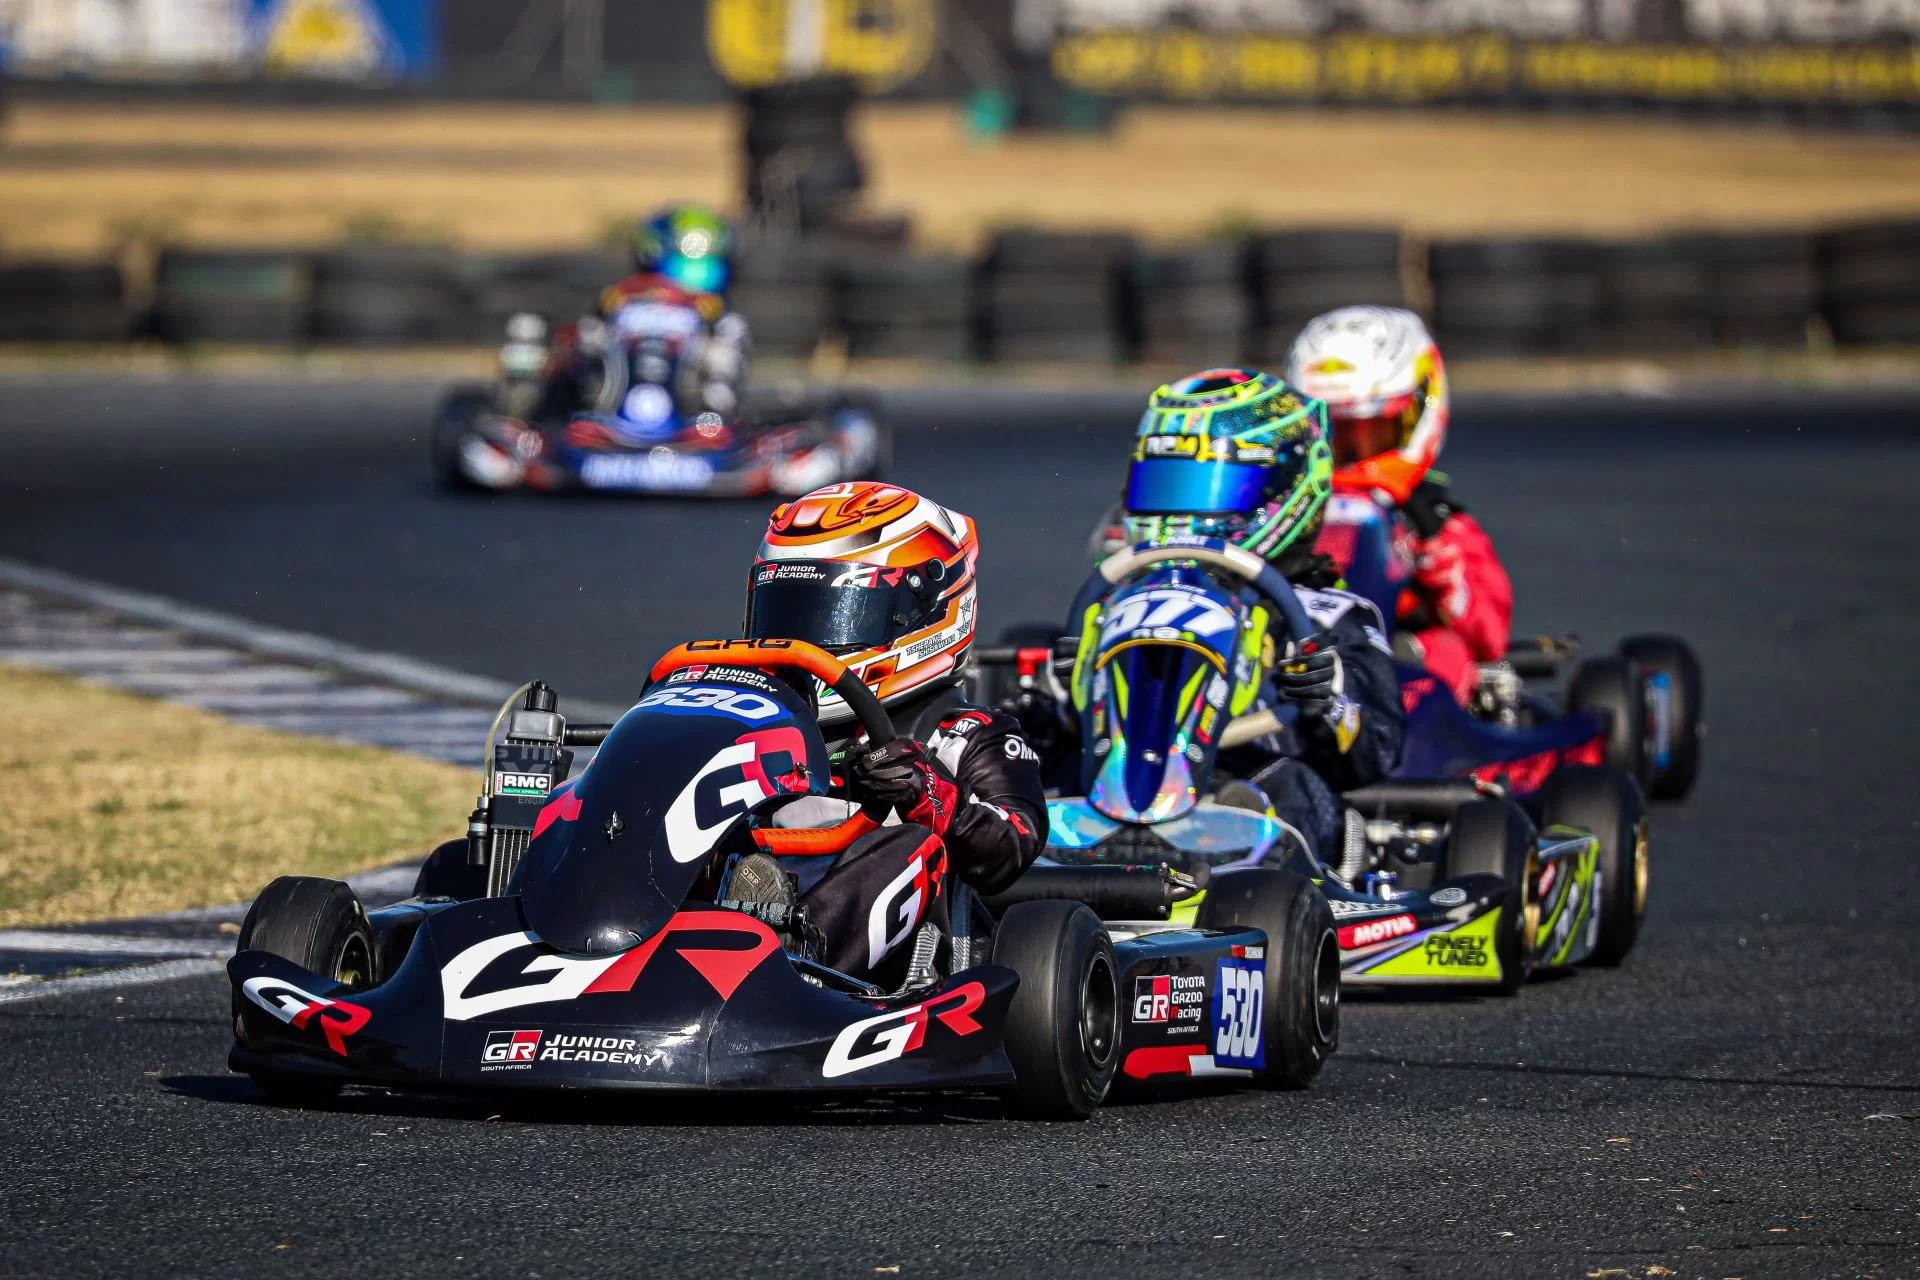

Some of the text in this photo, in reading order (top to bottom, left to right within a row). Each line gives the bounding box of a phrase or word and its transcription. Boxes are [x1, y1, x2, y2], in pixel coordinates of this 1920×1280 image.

[775, 571, 826, 580] ACADEMY
[777, 565, 817, 573] JUNIOR
[1101, 590, 1236, 647] 577
[704, 673, 778, 693] ACADEMY
[708, 666, 767, 683] JUNIOR
[870, 748, 888, 761] OMP
[503, 775, 548, 789] RMC
[1353, 913, 1416, 945] MOTUL
[441, 911, 780, 1021] GR
[1425, 951, 1488, 967] TUNED
[1171, 976, 1206, 989] TOYOTA
[1171, 991, 1203, 1004] GAZOO
[1135, 994, 1169, 1019] GR
[1170, 1005, 1202, 1022] Racing
[1216, 967, 1264, 1058] 530
[243, 976, 373, 1057] GR
[822, 981, 986, 1079] GR
[1167, 1026, 1182, 1034] SOUTH
[484, 1042, 536, 1060] GR
[545, 1034, 637, 1051] JUNIOR
[539, 1047, 659, 1066] ACADEMY
